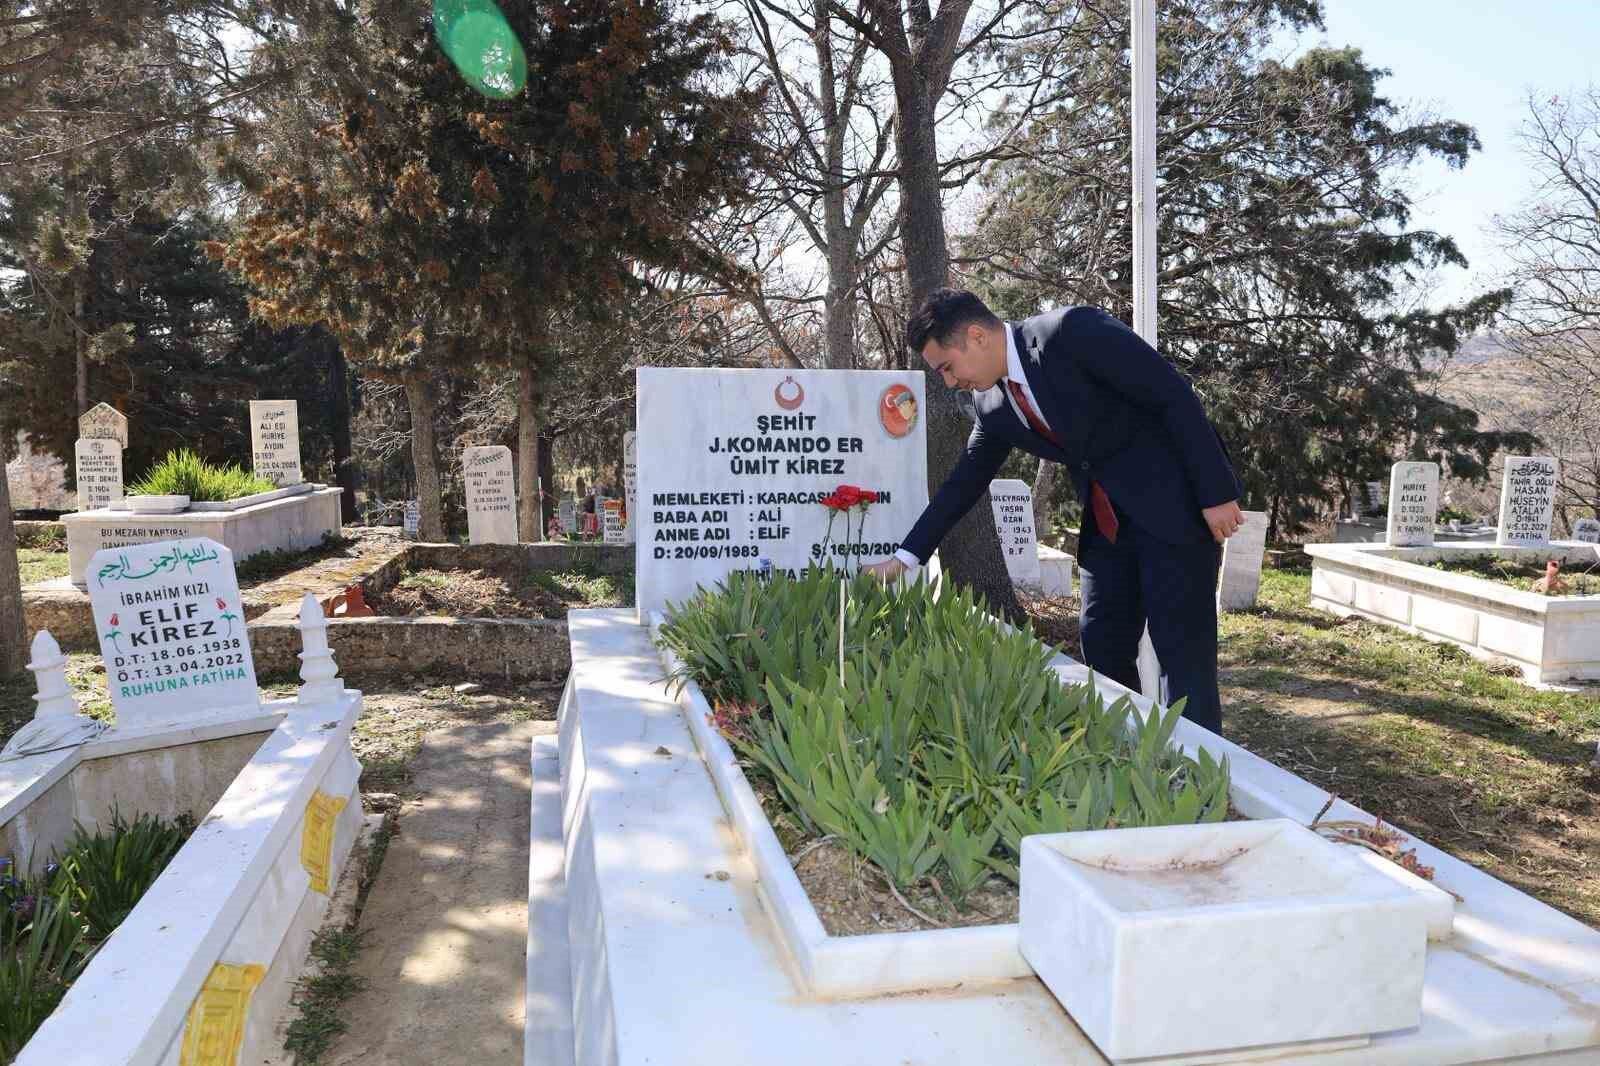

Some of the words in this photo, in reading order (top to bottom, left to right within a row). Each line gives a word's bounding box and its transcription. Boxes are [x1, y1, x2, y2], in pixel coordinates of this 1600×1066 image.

[757, 411, 817, 434] ŞEHİT
[709, 437, 831, 453] J.KOMANDO
[837, 437, 863, 453] ER
[730, 457, 780, 475] ÜMİT
[786, 457, 846, 475] KİREZ
[652, 489, 745, 506] MEMLEKETİ
[1514, 486, 1546, 494] HASAN
[1510, 496, 1549, 506] HÜSEYİN
[653, 511, 698, 524] BABA
[701, 510, 728, 523] ADI
[757, 507, 782, 522] ALİ
[1512, 506, 1545, 515] ATALAY
[101, 528, 112, 537] BU
[654, 528, 699, 542] ANNE
[703, 526, 730, 540] ADI
[758, 524, 791, 540] ELİF
[674, 545, 760, 560] 20/09/1983
[120, 585, 180, 606] İBRAHİM
[184, 582, 210, 597] KIZI
[138, 602, 200, 626] ELİF
[130, 620, 216, 647] KİREZ
[151, 638, 241, 662] 18.06.1938
[155, 653, 244, 678] 13.04.2022
[120, 676, 188, 698] RUHUNA
[192, 667, 247, 686] FATİHA
